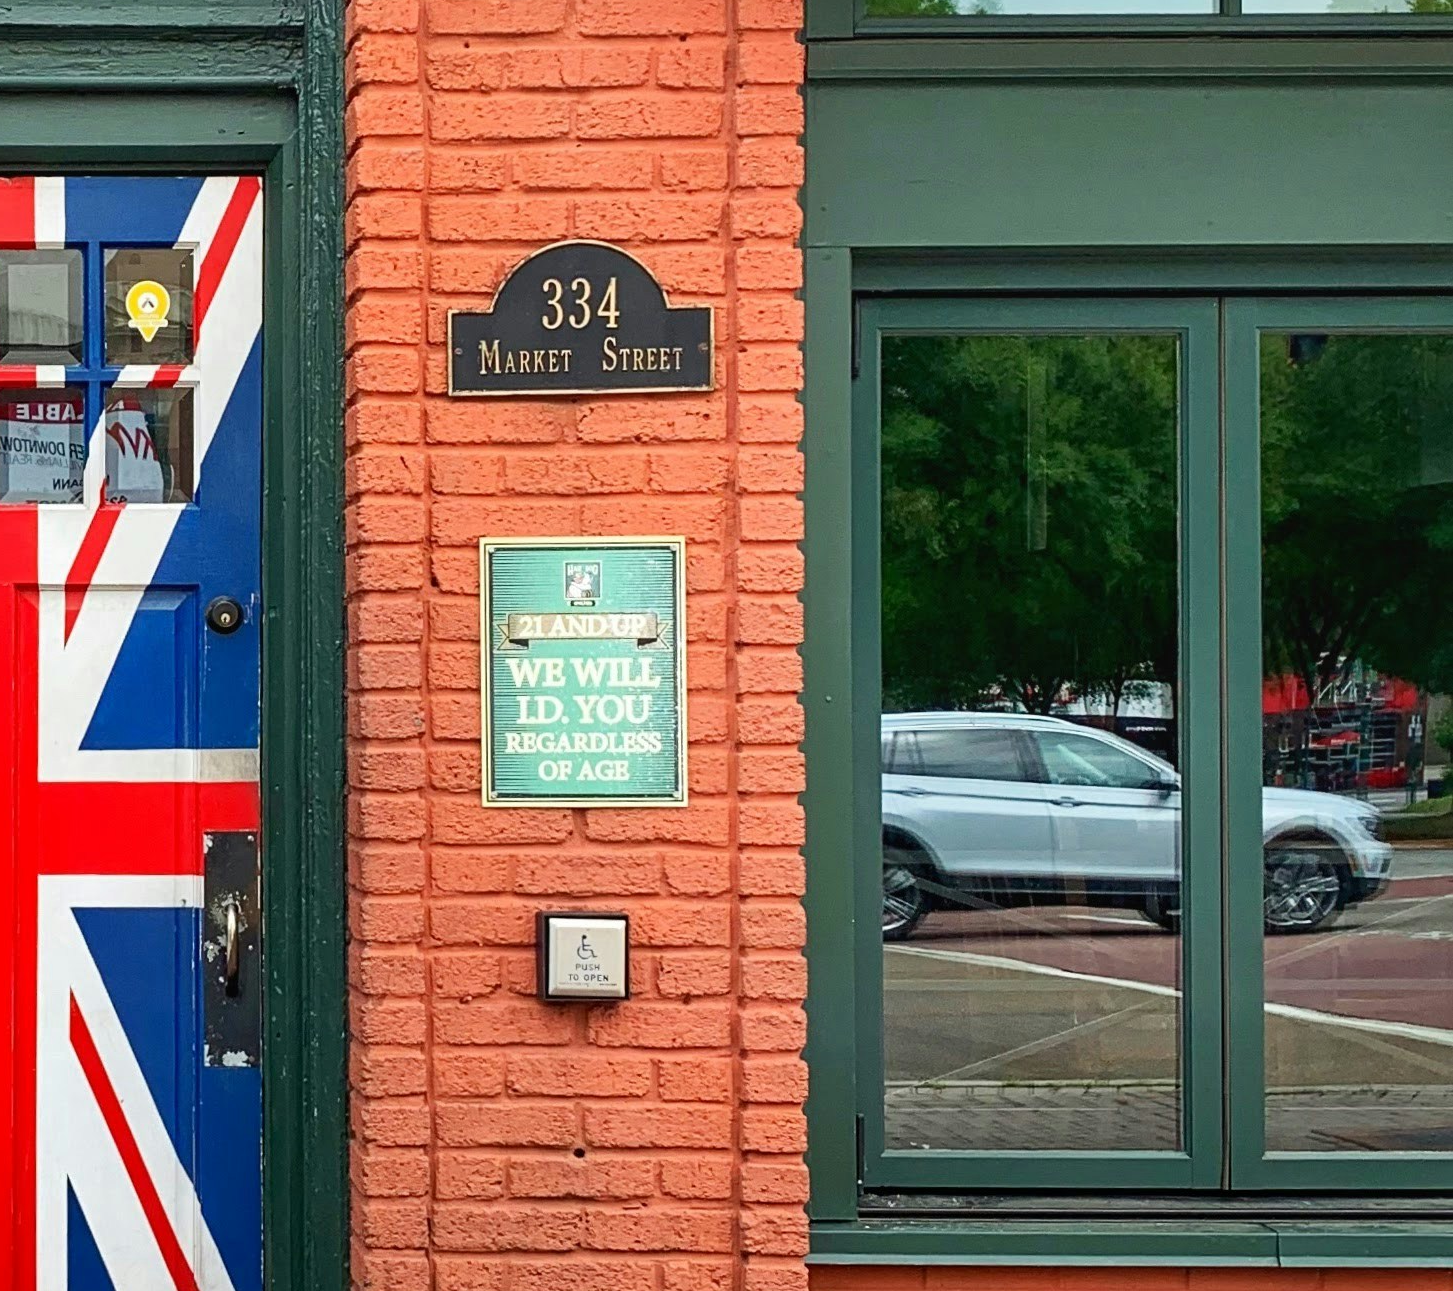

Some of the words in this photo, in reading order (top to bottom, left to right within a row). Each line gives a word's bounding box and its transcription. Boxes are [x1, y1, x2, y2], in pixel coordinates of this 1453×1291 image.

[542, 277, 620, 330] 334
[519, 616, 544, 638] 21
[551, 616, 606, 638] AND
[610, 616, 647, 638] UP
[505, 658, 566, 688] WE
[570, 658, 661, 688] WILL
[573, 695, 653, 725] YOU
[504, 732, 663, 754] REGARDLESS
[538, 761, 572, 781] OF
[576, 761, 630, 781] AGE
[575, 963, 601, 971] PUSH
[583, 974, 609, 982] OPEN
